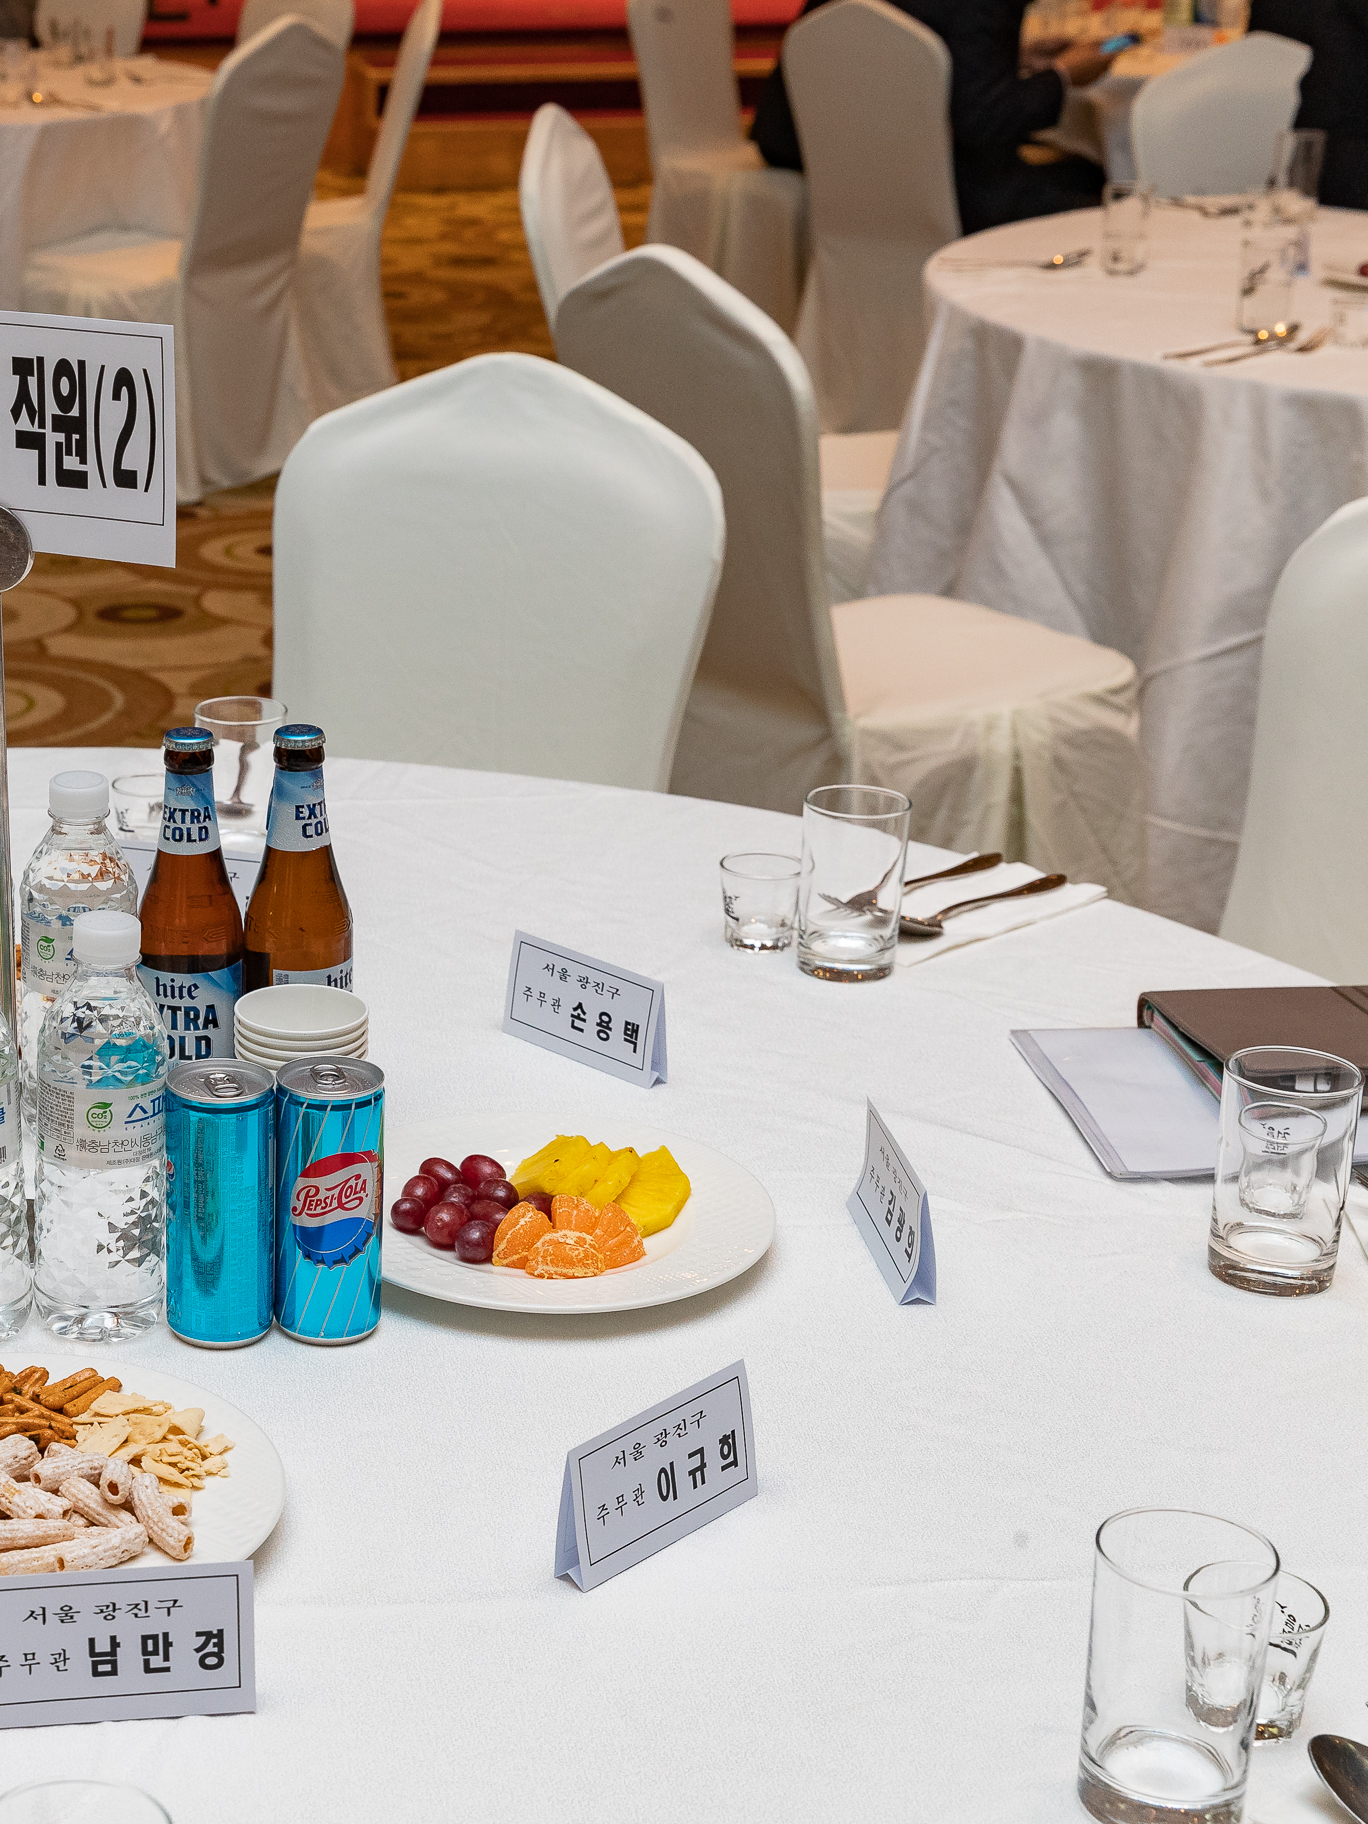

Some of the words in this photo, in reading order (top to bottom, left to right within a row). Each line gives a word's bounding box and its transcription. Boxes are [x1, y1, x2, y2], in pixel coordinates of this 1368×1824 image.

[10, 356, 157, 493] 직원(2)
[163, 803, 212, 825] EXTRA
[294, 799, 327, 821] EXT
[163, 825, 210, 843] COLD
[302, 820, 330, 839] COL
[154, 976, 200, 1001] hite
[542, 962, 571, 983] 서울
[576, 975, 621, 1000] 광진구
[154, 1003, 221, 1032] TRA
[522, 985, 562, 1014] 주무관
[570, 1001, 640, 1054] 손용택
[166, 1034, 213, 1061] OLD
[124, 1092, 165, 1125] 스파
[611, 1441, 647, 1470] 서울
[653, 1409, 707, 1448] 광진구
[596, 1483, 646, 1527] 주무관
[656, 1429, 739, 1502] 이규희
[22, 1603, 81, 1626] 서울
[93, 1598, 184, 1622] 광진구
[87, 1628, 226, 1678] 남만경
